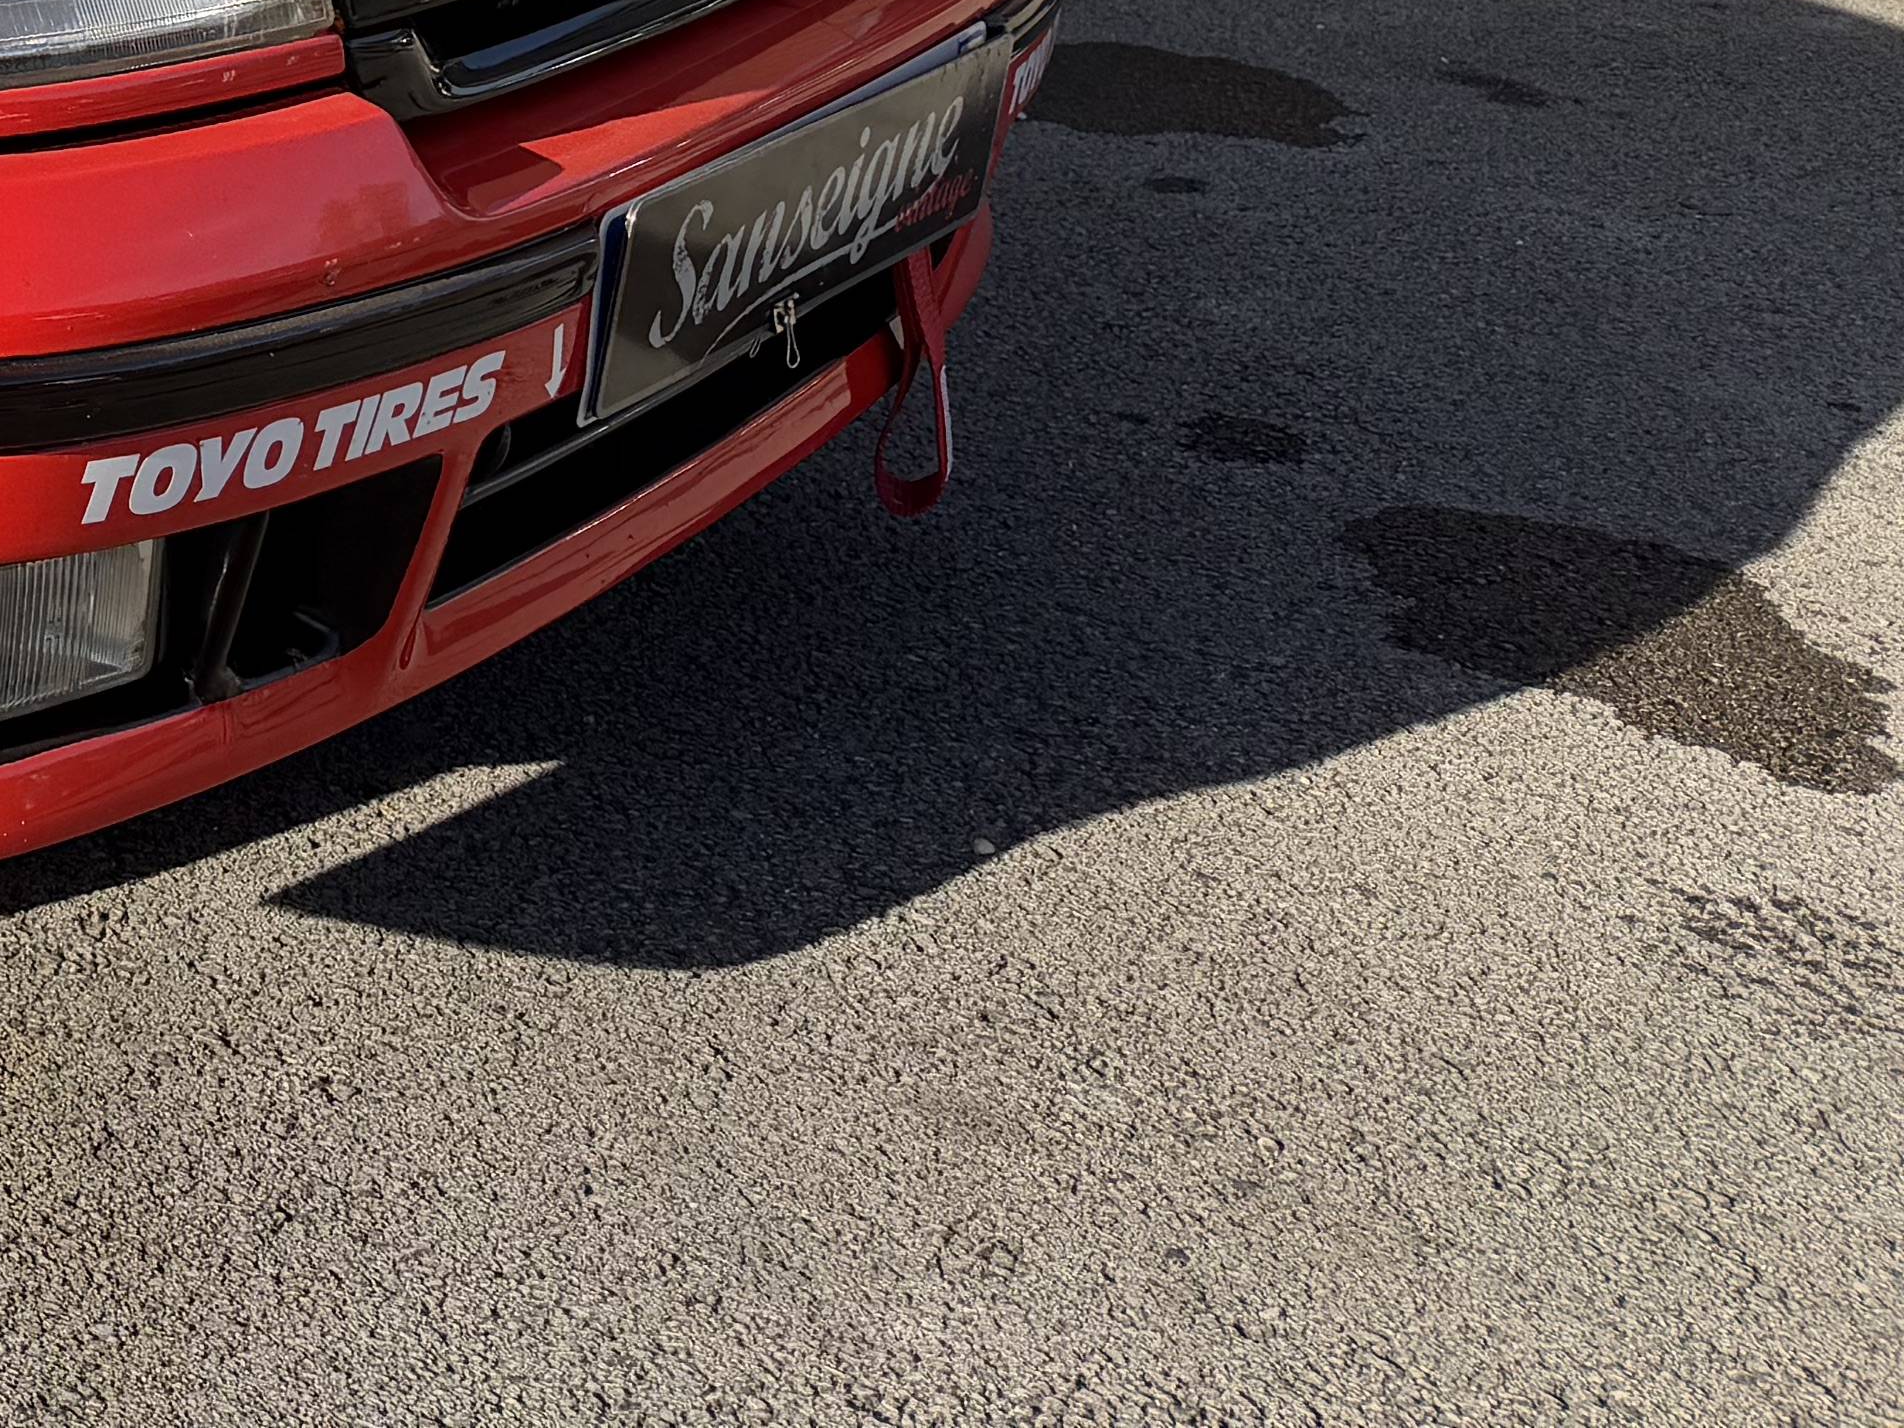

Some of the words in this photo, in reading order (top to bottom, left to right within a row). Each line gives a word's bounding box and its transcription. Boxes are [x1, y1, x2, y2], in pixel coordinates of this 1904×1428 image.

[648, 95, 965, 350] Sanseigne
[80, 417, 306, 526] TOYO
[310, 349, 506, 471] TIRES
